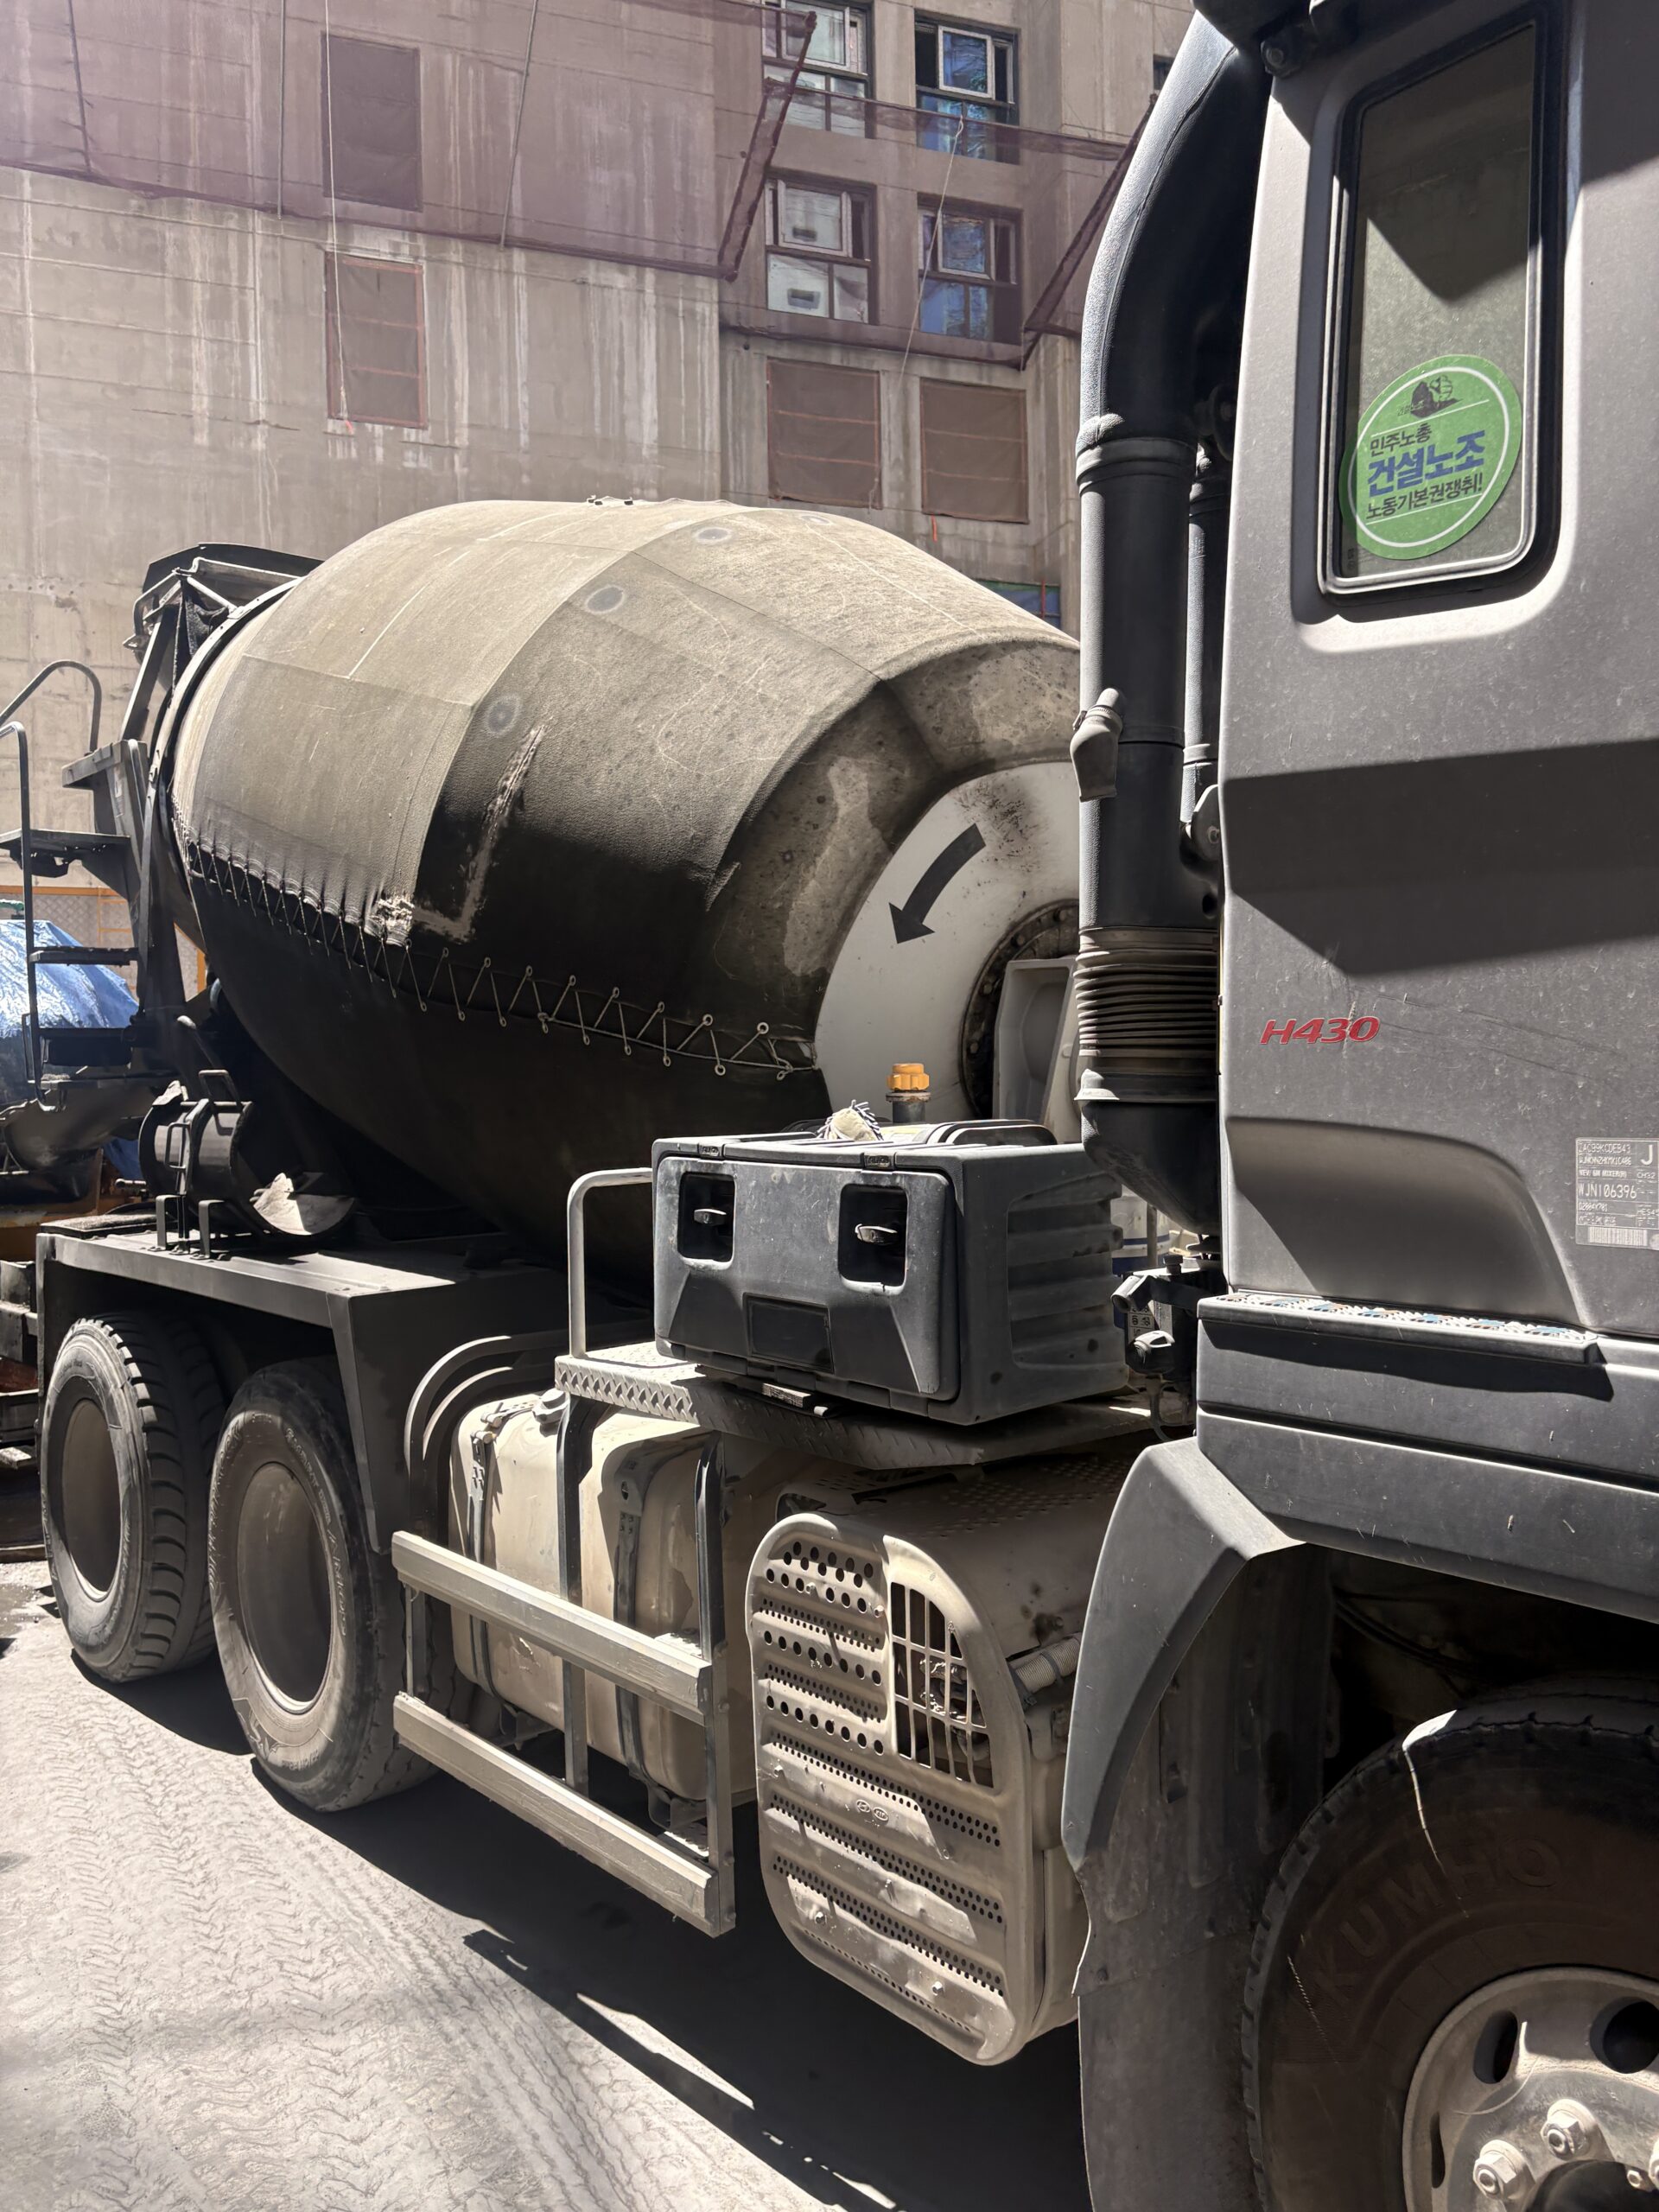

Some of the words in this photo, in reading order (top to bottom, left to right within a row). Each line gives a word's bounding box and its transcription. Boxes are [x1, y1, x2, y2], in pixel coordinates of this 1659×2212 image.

[1370, 423, 1432, 457] 민주노총
[1368, 429, 1485, 498] 건설노조
[1366, 473, 1483, 519] 노동기본권쟁취!
[1260, 1016, 1380, 1044] H430
[1640, 1144, 1654, 1166] J
[1312, 1837, 1562, 2003] KUMHO
